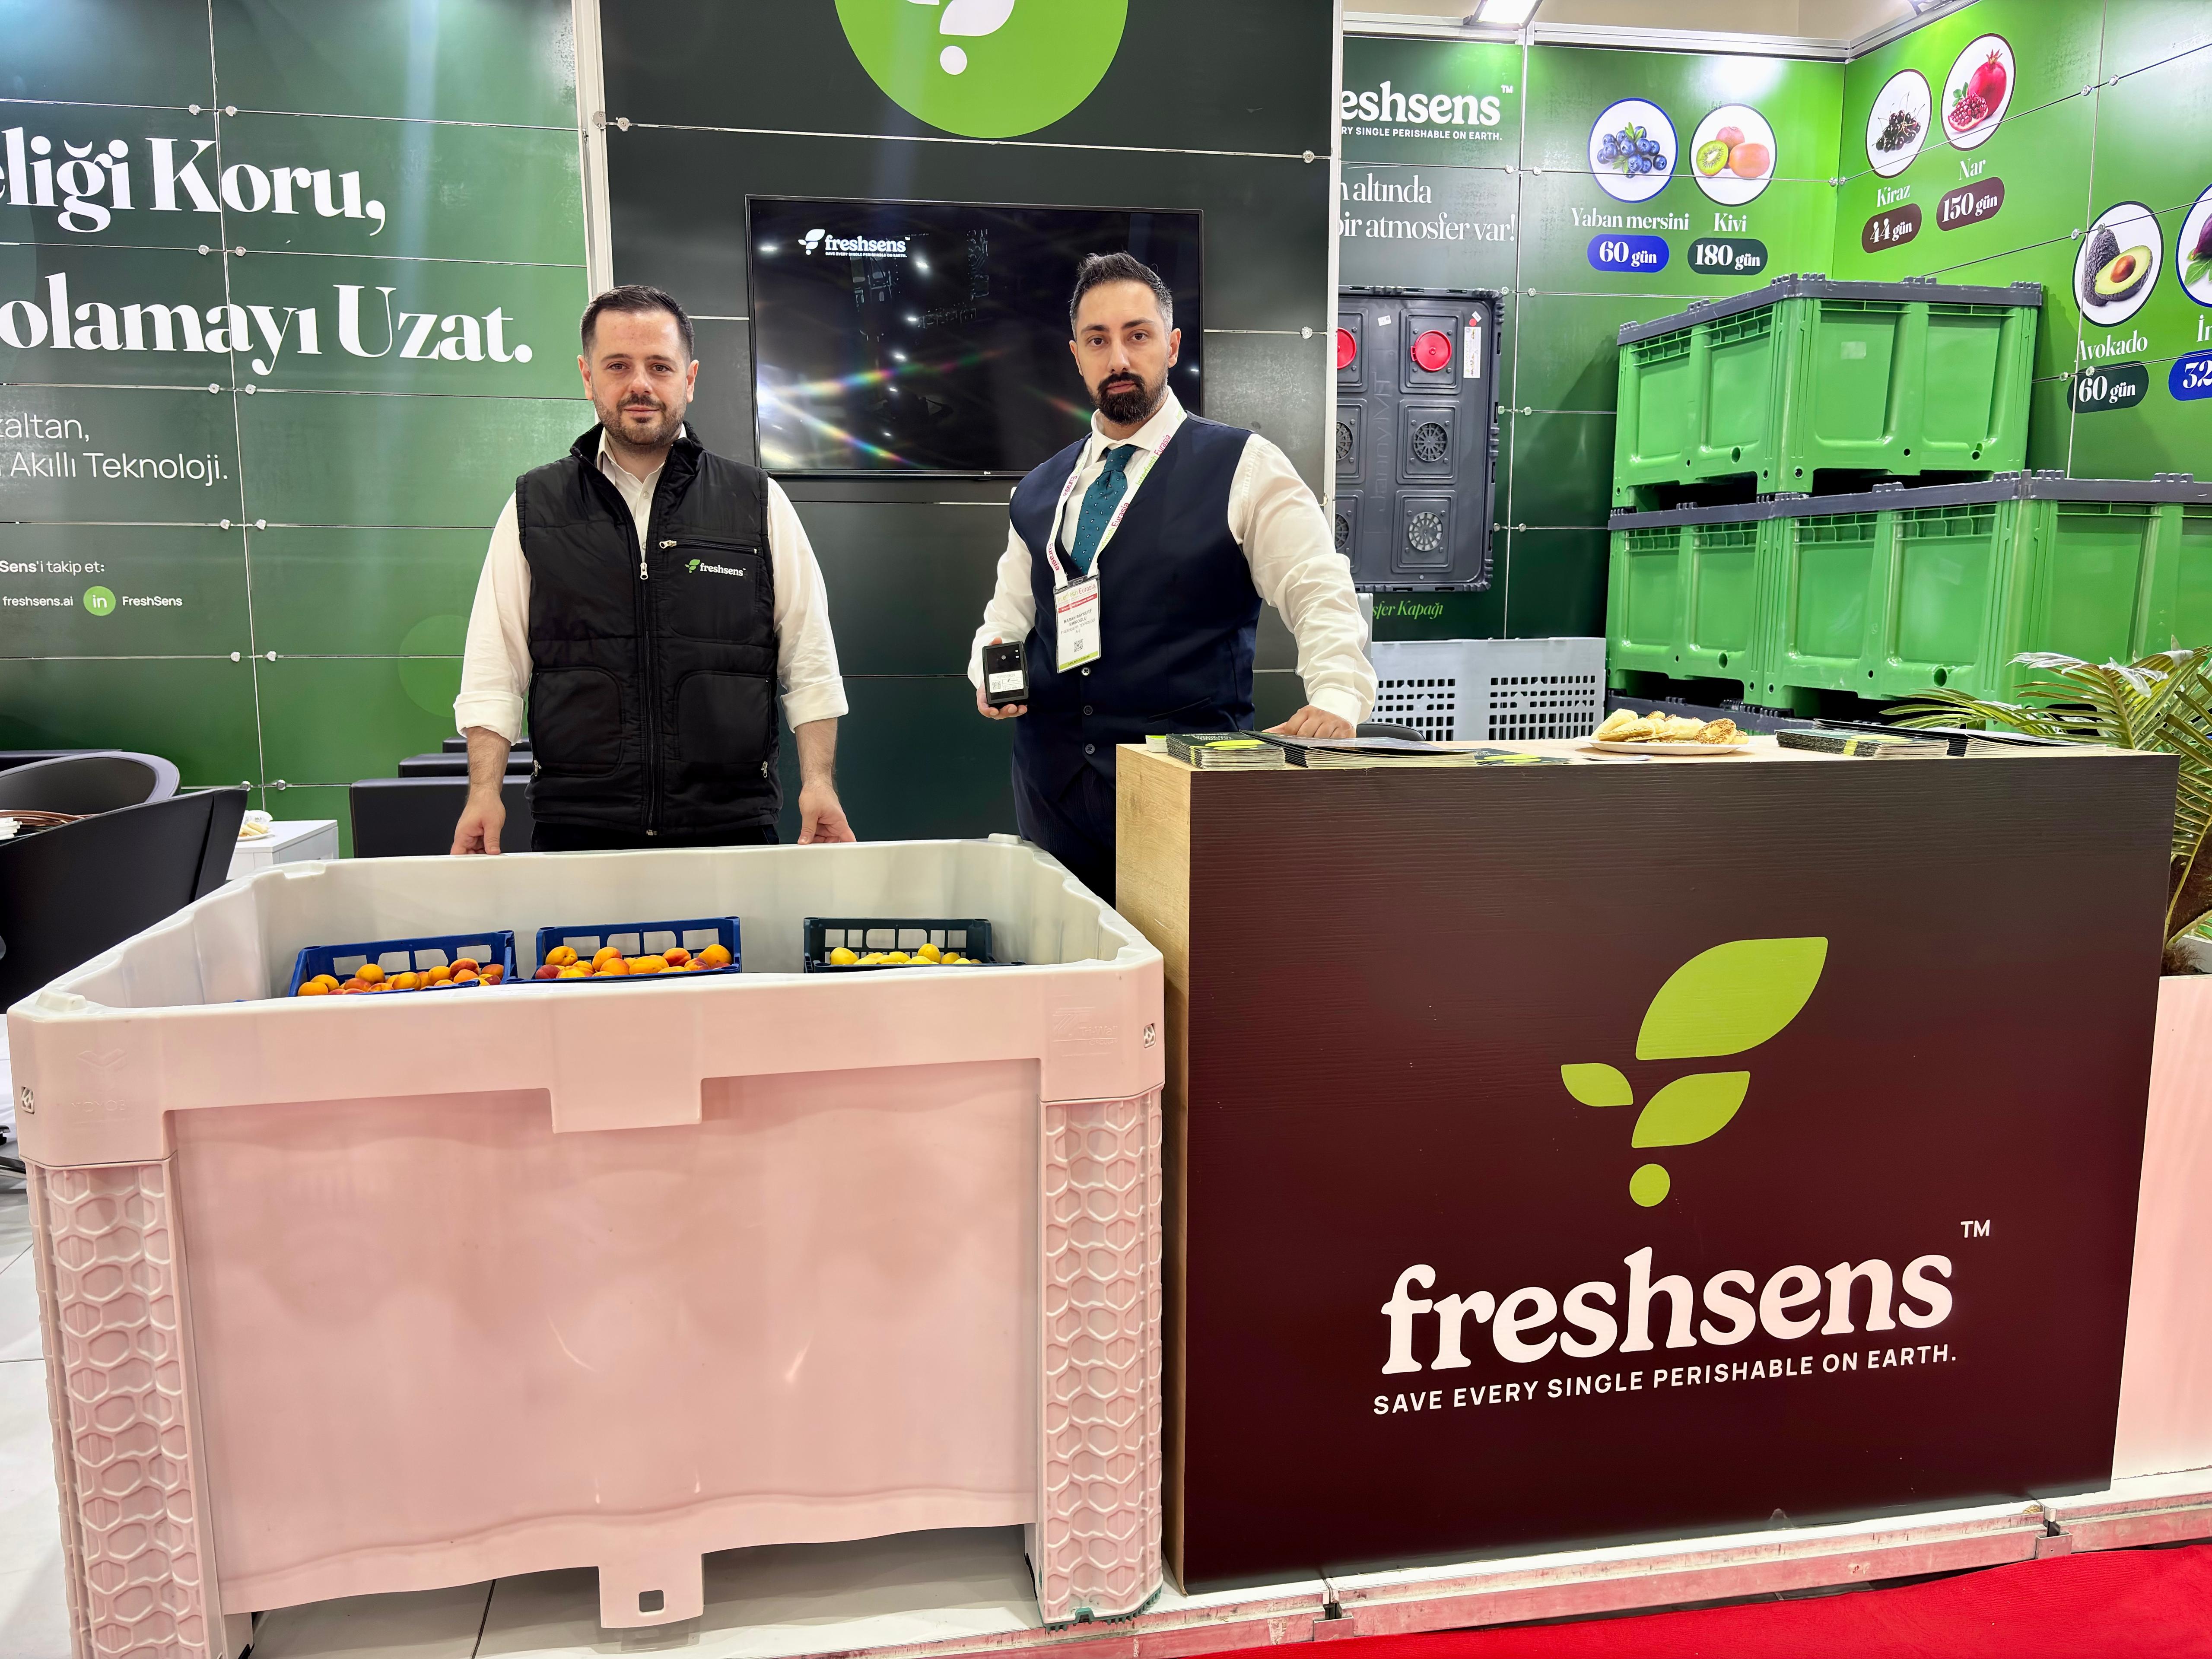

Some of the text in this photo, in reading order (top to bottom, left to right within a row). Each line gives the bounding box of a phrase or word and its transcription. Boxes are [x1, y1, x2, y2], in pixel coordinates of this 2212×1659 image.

[1355, 127, 1390, 137] SINGLE
[1392, 128, 1451, 140] PERISHABLE
[1452, 131, 1467, 140] ON
[1469, 132, 1503, 141] EARTH.
[0, 126, 387, 236] liği Koru,
[1958, 158, 1986, 181] Nar
[1353, 172, 1432, 204] altında
[1877, 184, 1910, 207] Kiraz
[1571, 207, 1690, 230] Yaban mersini
[1942, 192, 1998, 222] 150 gün
[1365, 212, 1470, 241] atmosfer
[1475, 213, 1516, 242] var!
[1713, 213, 1747, 232] Kivi
[1869, 218, 1913, 243] 44 gün
[824, 234, 906, 253] freshsens
[1599, 241, 1657, 268] 60 gün
[1694, 244, 1761, 271] 180 gün
[0, 272, 533, 376] olamayı Uzat.
[2074, 330, 2148, 362] Avokado
[2079, 375, 2136, 404] 60 gün
[0, 413, 89, 442] altan,
[10, 451, 229, 486] Akıllı Teknoloji.
[1135, 434, 1171, 485] Interfresh Eurasia
[1063, 476, 1077, 496] Eurasia
[1111, 502, 1130, 527] Eurasia
[46, 560, 82, 576] takip
[84, 561, 105, 573] et:
[1048, 542, 1060, 571] Eurasia
[700, 563, 744, 576] freshsens
[2, 596, 73, 606] freshsens.ai
[122, 596, 183, 607] FreshSens
[1078, 584, 1096, 594] Eurasia
[1076, 609, 1092, 619] BAYKURT
[1397, 601, 1443, 620] Kapağı
[1960, 1219, 1991, 1239] TM
[1381, 1246, 1953, 1376] freshsens
[1373, 1344, 1956, 1415] SAVE EVERY SINGLE PERISHABLE ON EARTH.
